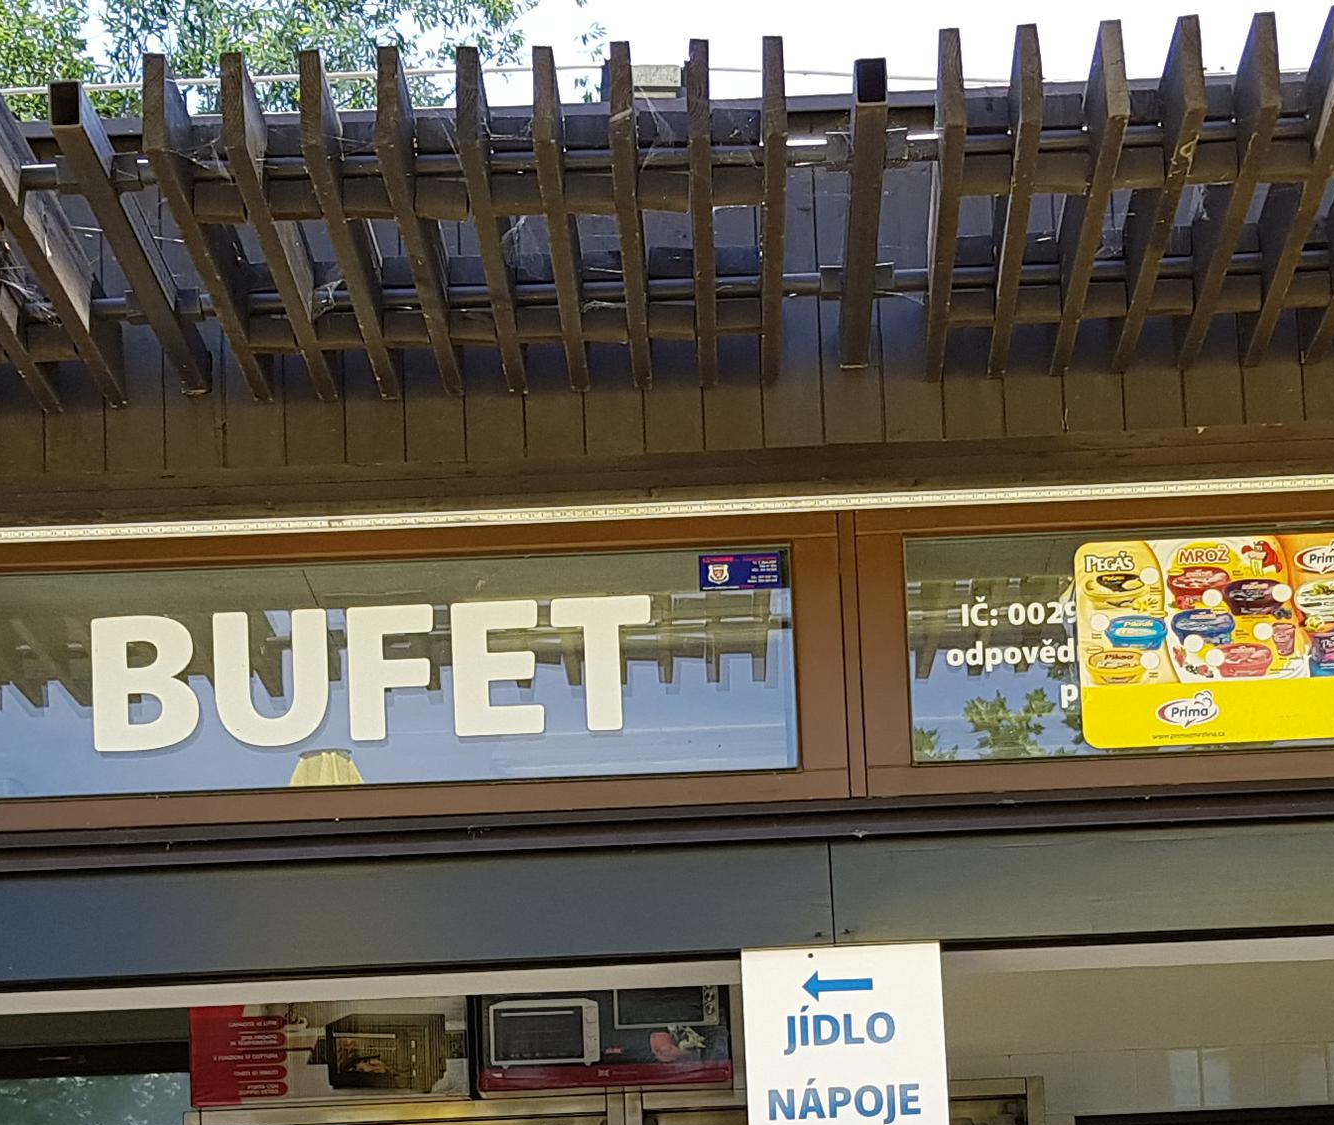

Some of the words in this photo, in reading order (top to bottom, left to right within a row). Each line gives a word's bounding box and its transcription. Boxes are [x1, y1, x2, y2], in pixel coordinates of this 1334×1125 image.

[1179, 545, 1230, 565] MROŽ
[961, 596, 999, 627] IČ:
[91, 595, 653, 752] BUFET
[1169, 703, 1210, 719] Prima
[783, 1005, 896, 1056] JÍDLO
[768, 1078, 921, 1125] NÁPOJE
